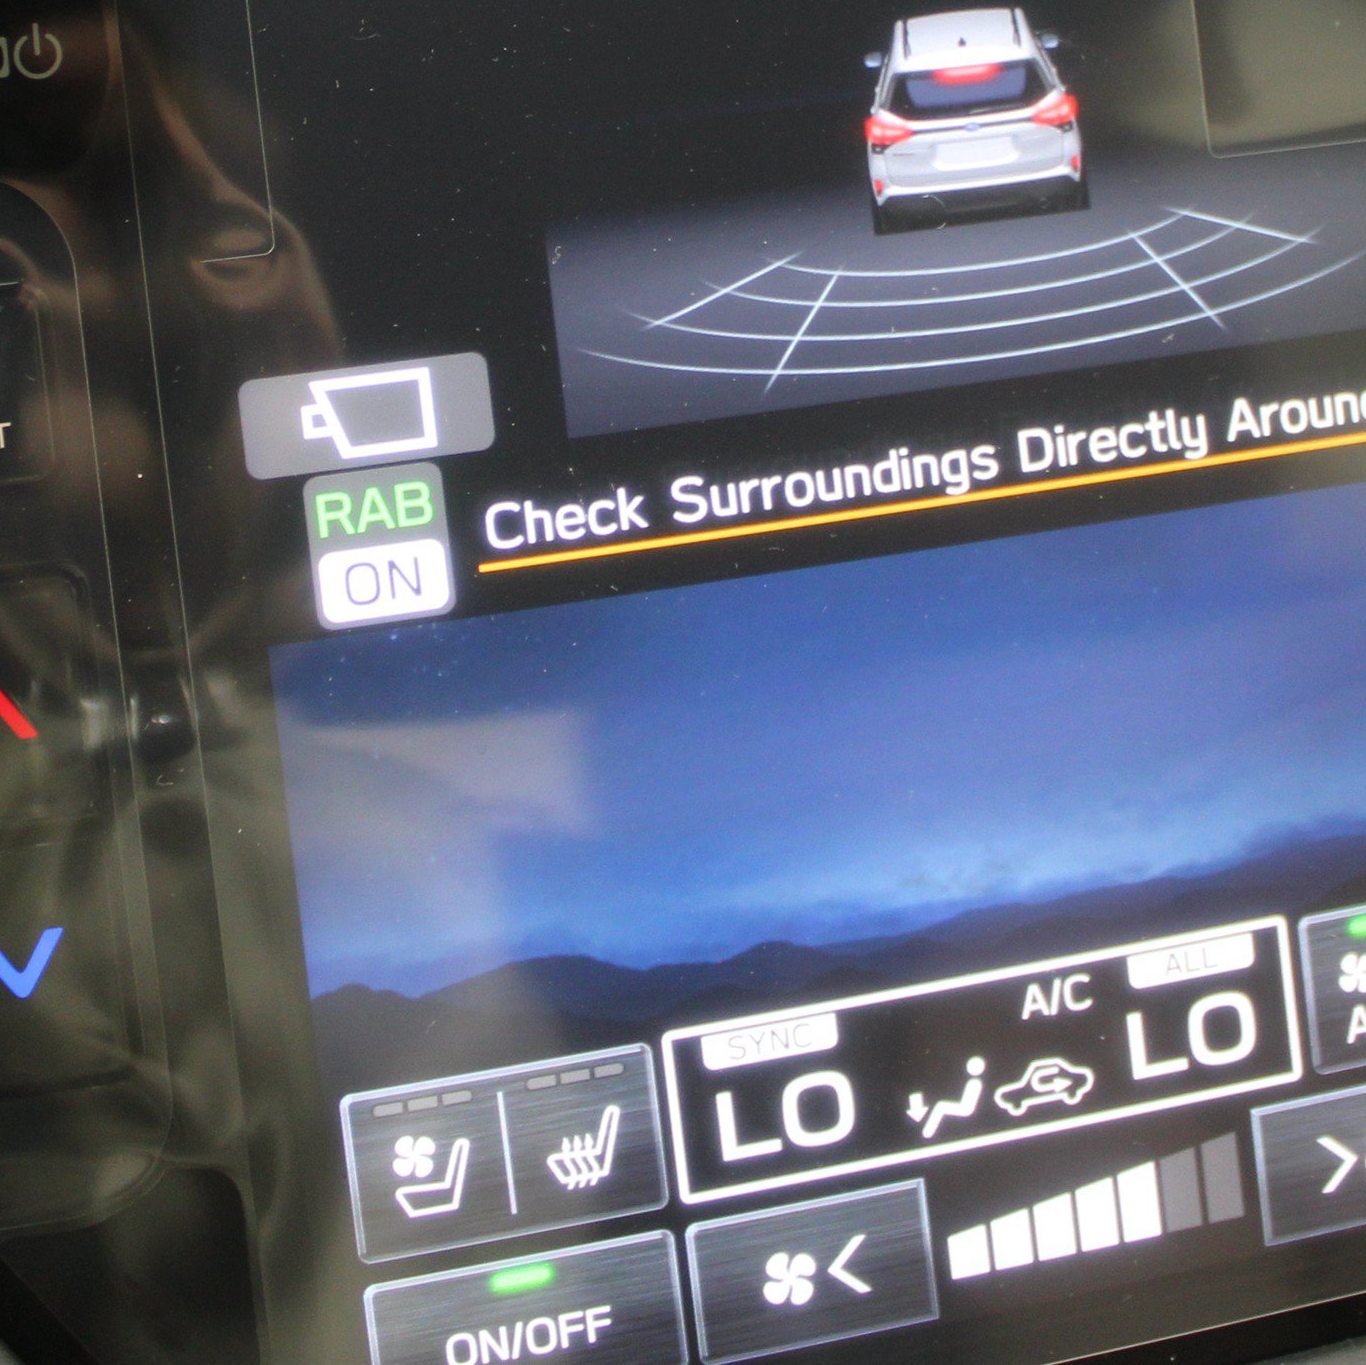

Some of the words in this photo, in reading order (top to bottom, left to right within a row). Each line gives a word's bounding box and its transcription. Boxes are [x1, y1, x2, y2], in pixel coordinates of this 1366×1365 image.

[483, 486, 649, 551] Check
[669, 442, 1001, 525] Surroundings
[1017, 409, 1210, 475] Directly
[314, 481, 435, 540] RAB
[343, 558, 423, 608] ON
[1164, 947, 1220, 978] ALL
[1020, 972, 1095, 1021] A/C
[727, 1022, 813, 1061] SYNC
[1125, 989, 1258, 1081] LO
[715, 1069, 856, 1163] LO
[445, 1304, 613, 1365] ON/OFF
